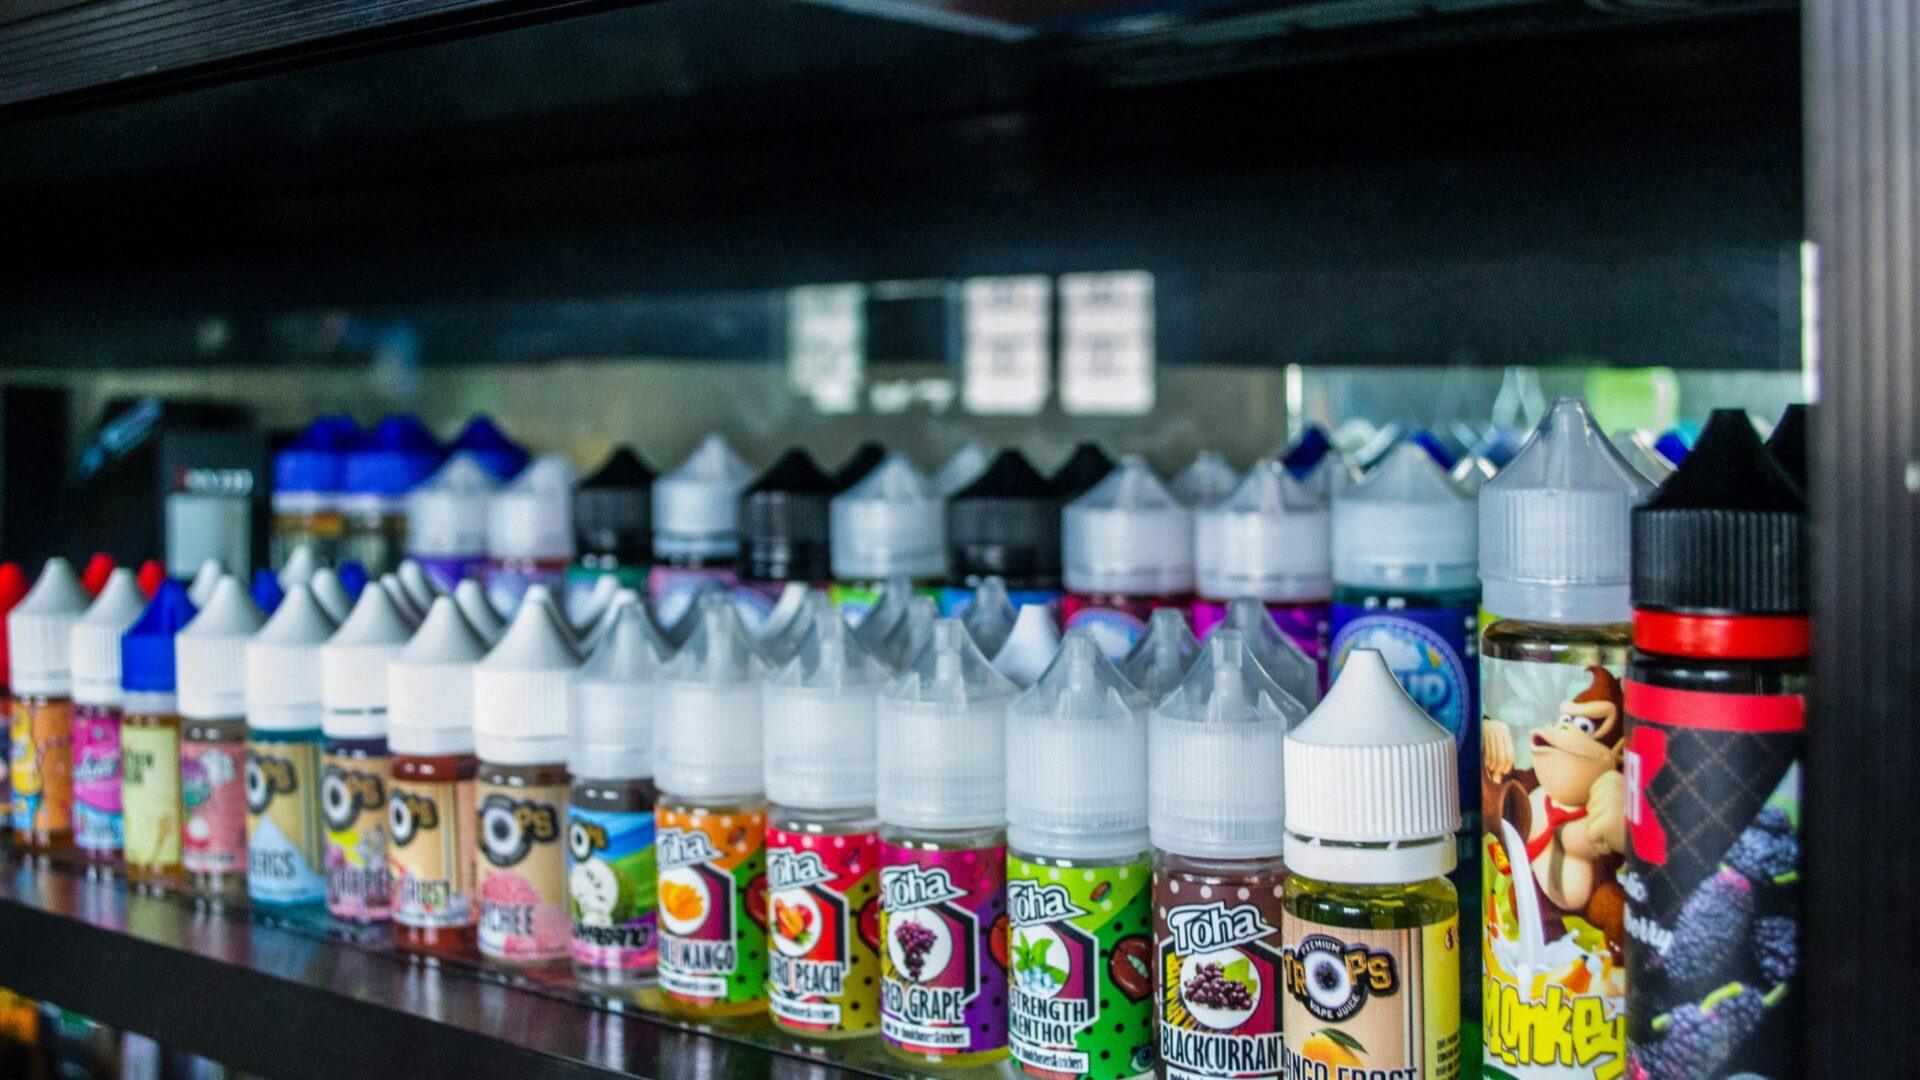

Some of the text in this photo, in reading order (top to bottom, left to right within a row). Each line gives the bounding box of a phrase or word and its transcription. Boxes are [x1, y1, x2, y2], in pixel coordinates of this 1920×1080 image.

[881, 866, 957, 910] Toha
[1007, 881, 1078, 926] Toha
[1168, 903, 1268, 955] Toha
[1301, 939, 1341, 956] PREMIUM
[795, 963, 840, 992] PEACH
[909, 988, 961, 1020] GRAPE
[1309, 993, 1361, 1019] VAPE JUICE
[1162, 1024, 1284, 1071] BLACKCURRANT
